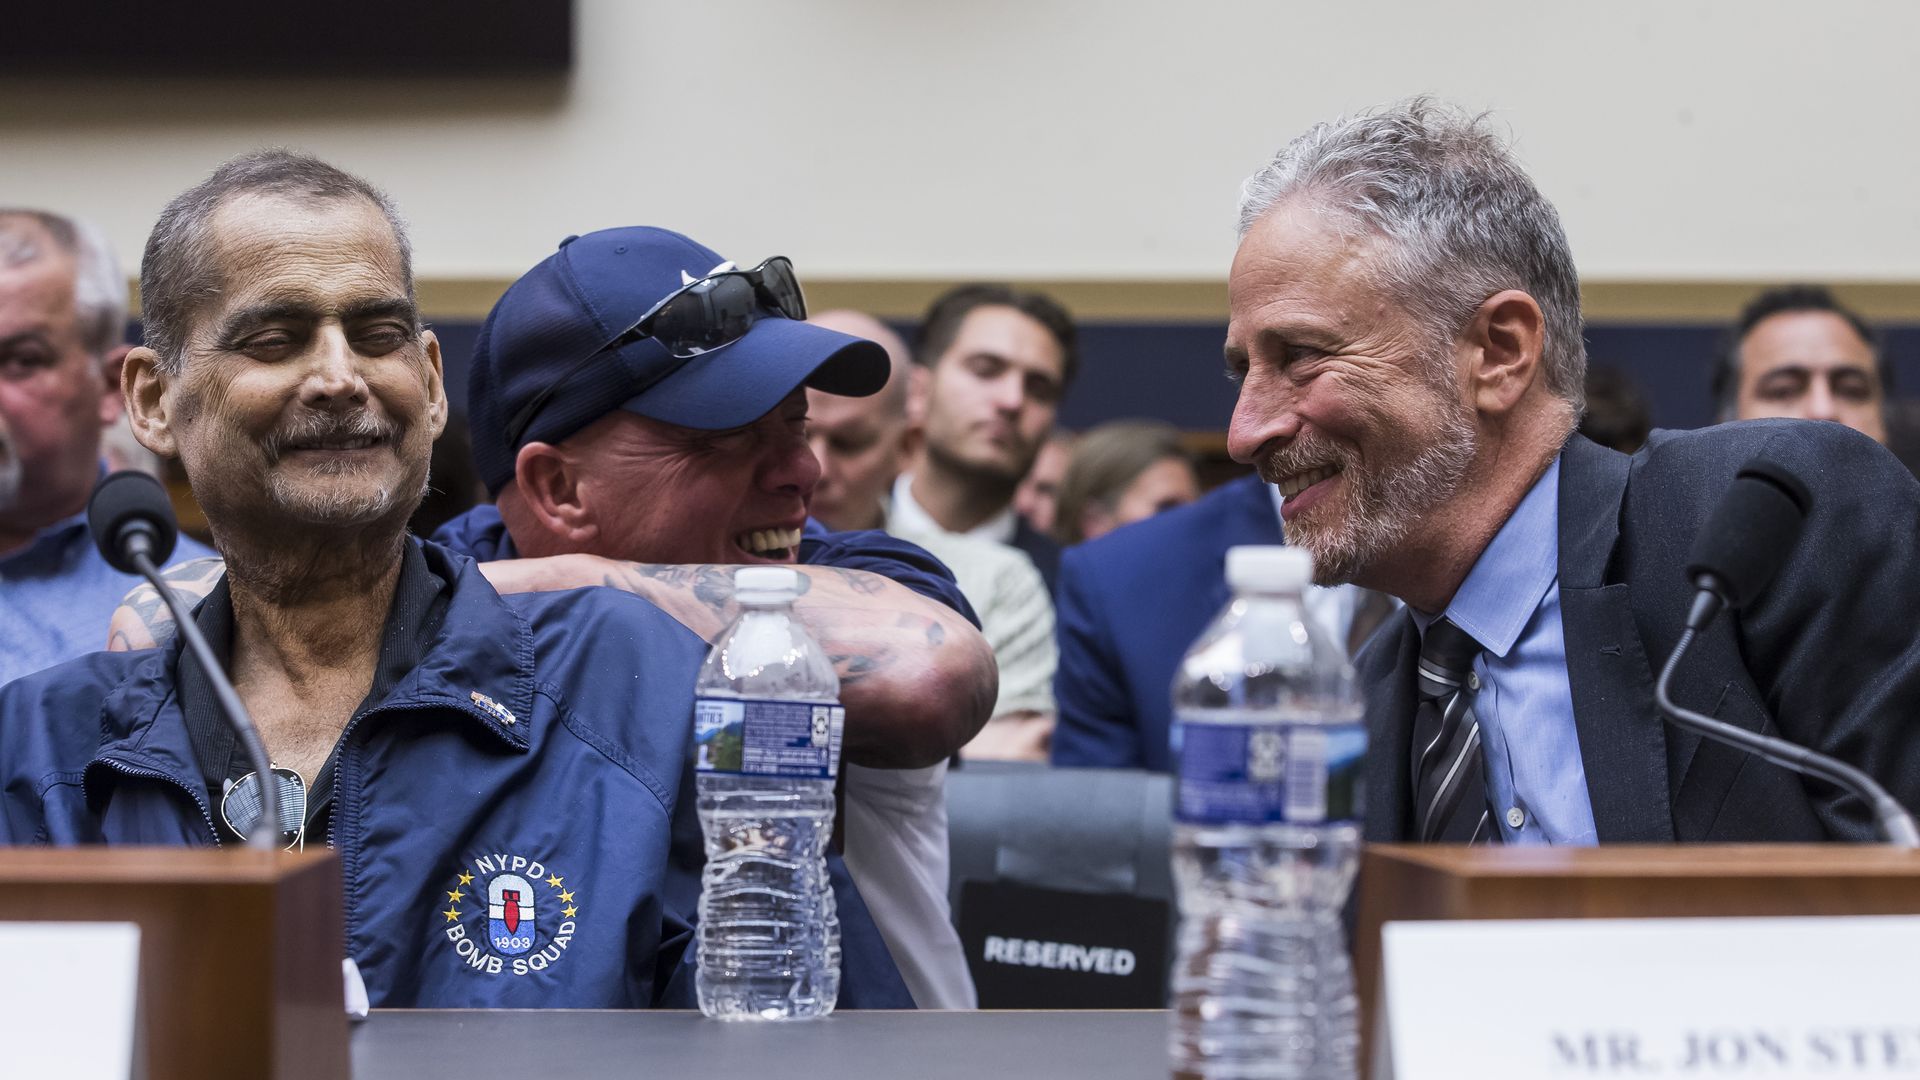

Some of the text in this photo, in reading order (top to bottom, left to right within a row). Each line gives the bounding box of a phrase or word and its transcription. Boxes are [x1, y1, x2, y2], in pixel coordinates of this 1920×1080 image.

[474, 853, 545, 880] NYPD
[446, 921, 576, 976] BOMB SQUAD
[494, 936, 531, 949] 1903
[984, 935, 1136, 976] RESERVED
[1550, 1027, 1920, 1074] MR. JON STE
